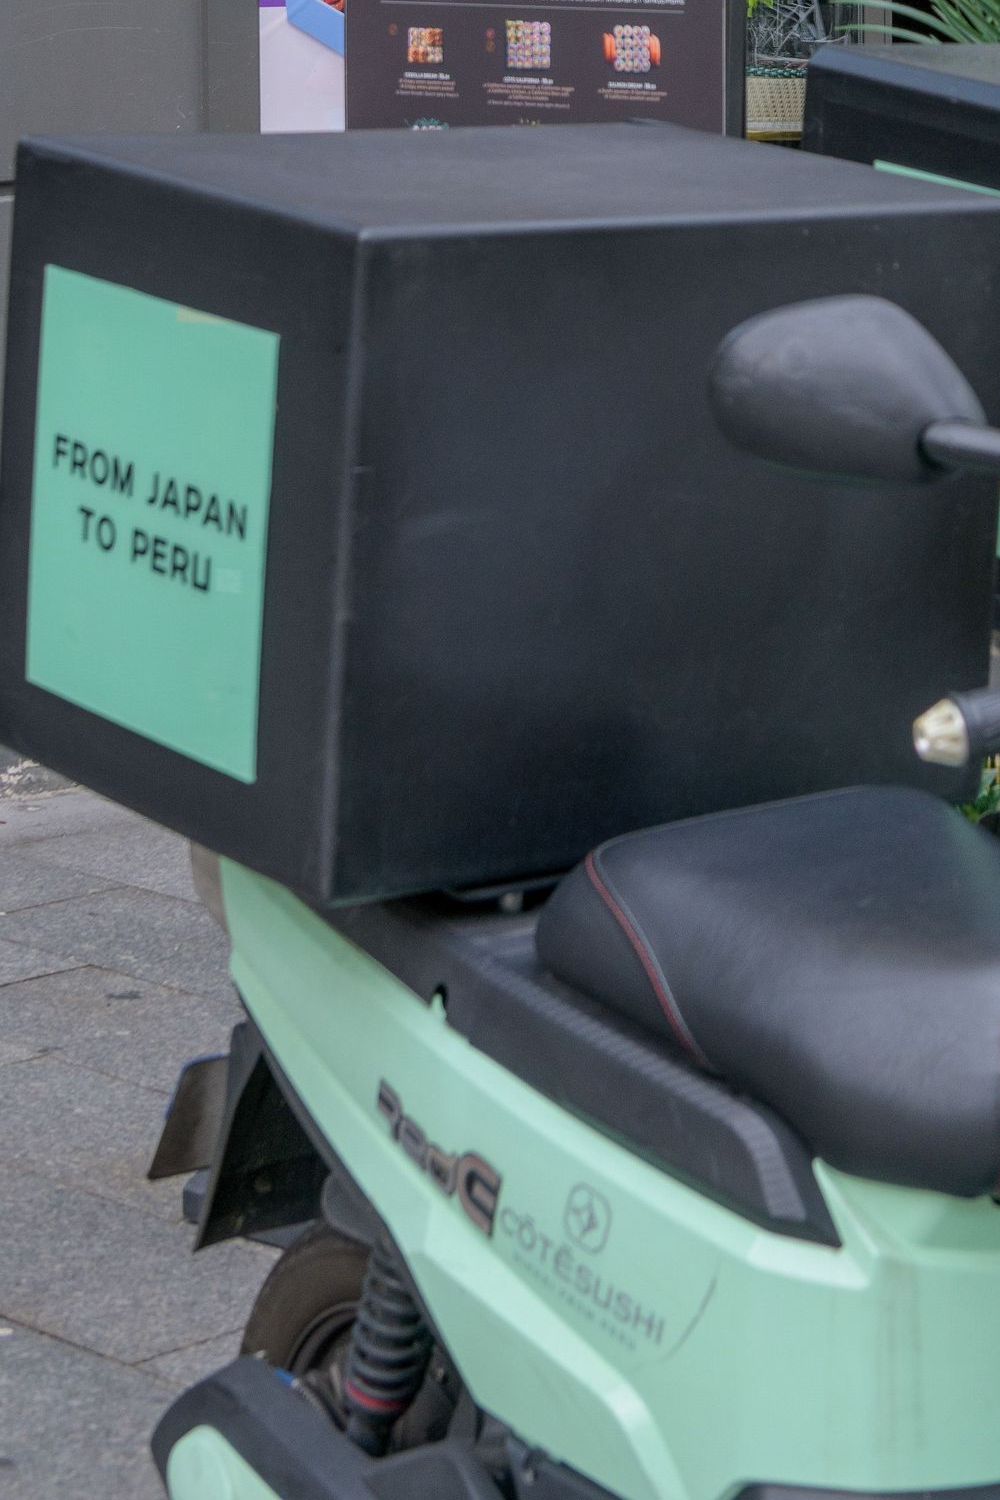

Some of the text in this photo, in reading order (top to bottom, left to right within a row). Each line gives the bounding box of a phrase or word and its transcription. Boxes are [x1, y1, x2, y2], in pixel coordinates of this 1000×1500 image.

[53, 432, 249, 542] FROM JAPAN
[78, 504, 213, 594] TO PERU
